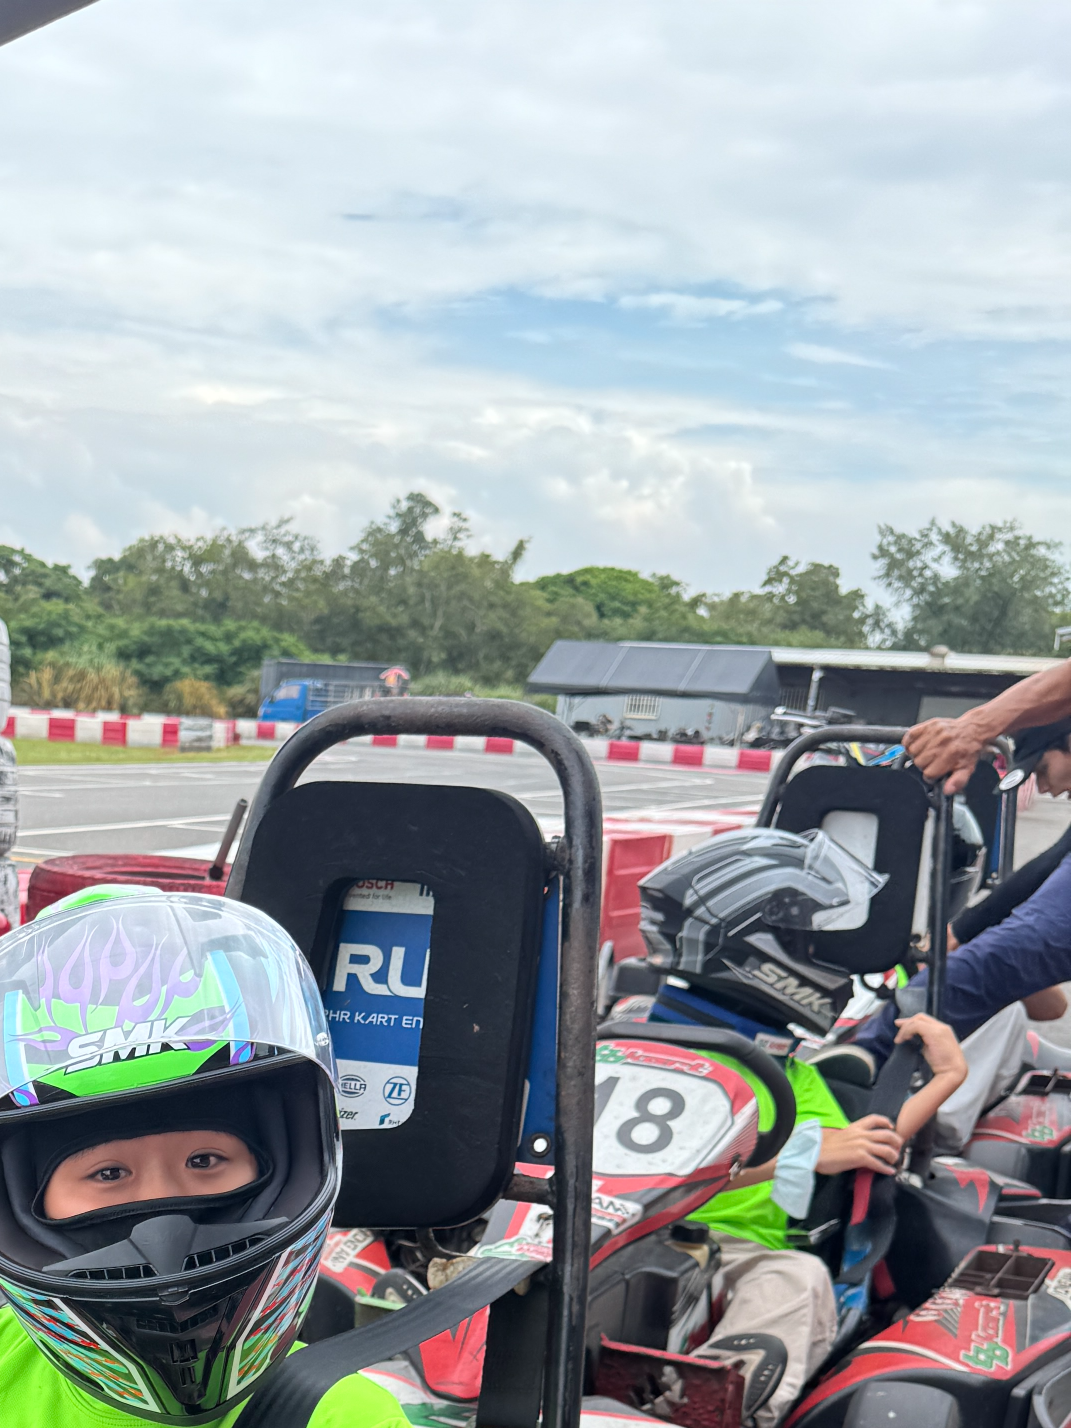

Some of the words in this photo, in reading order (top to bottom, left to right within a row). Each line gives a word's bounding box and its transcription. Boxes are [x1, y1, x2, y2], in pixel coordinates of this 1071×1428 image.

[355, 880, 395, 891] OSCH
[751, 962, 832, 1014] SMK
[354, 1012, 398, 1027] KART
[64, 1016, 191, 1076] SMK
